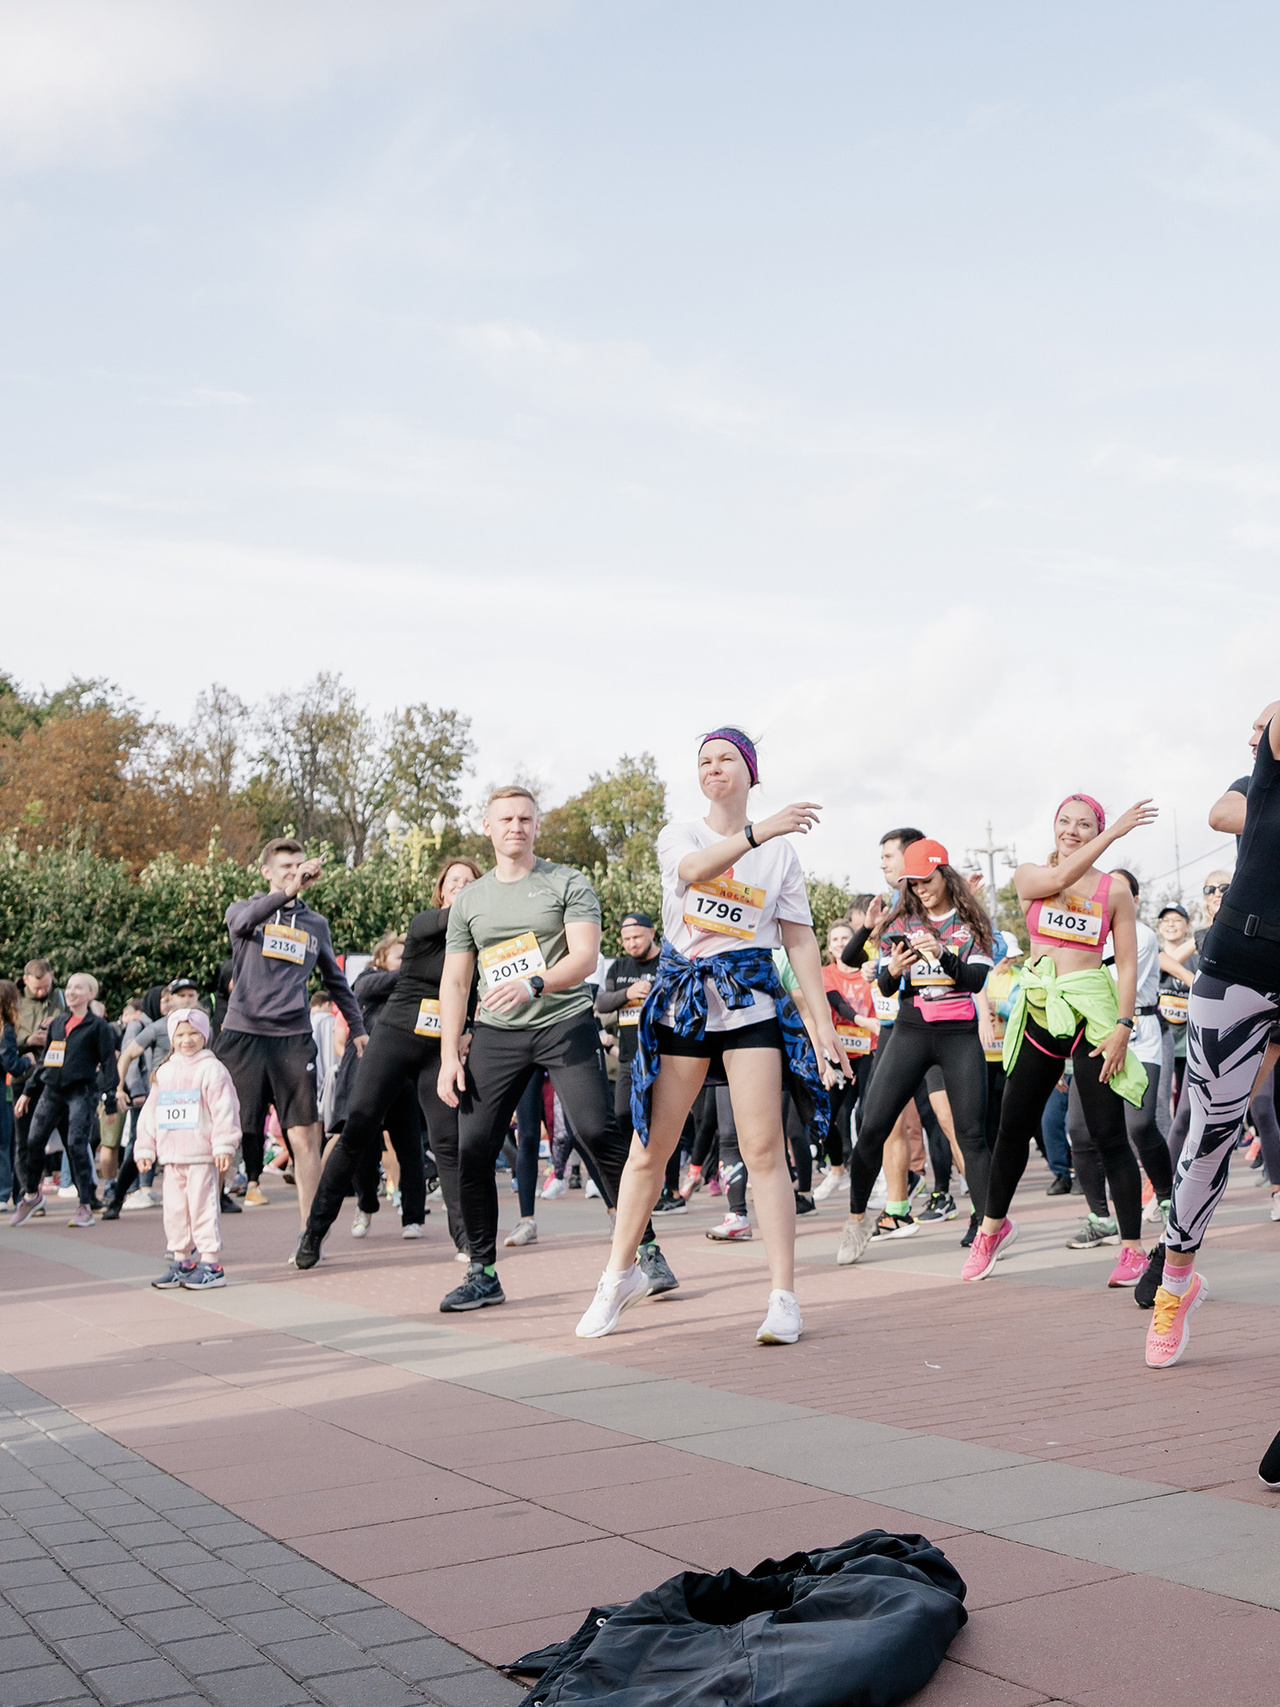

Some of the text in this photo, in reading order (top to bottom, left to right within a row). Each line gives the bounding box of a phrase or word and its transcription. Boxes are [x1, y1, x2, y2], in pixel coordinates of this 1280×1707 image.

[696, 898, 744, 922] 1796
[1047, 912, 1088, 932] 1403
[269, 939, 297, 954] 2136
[491, 958, 530, 982] 2013
[1163, 1008, 1188, 1019] 1943
[166, 1108, 187, 1120] 101
